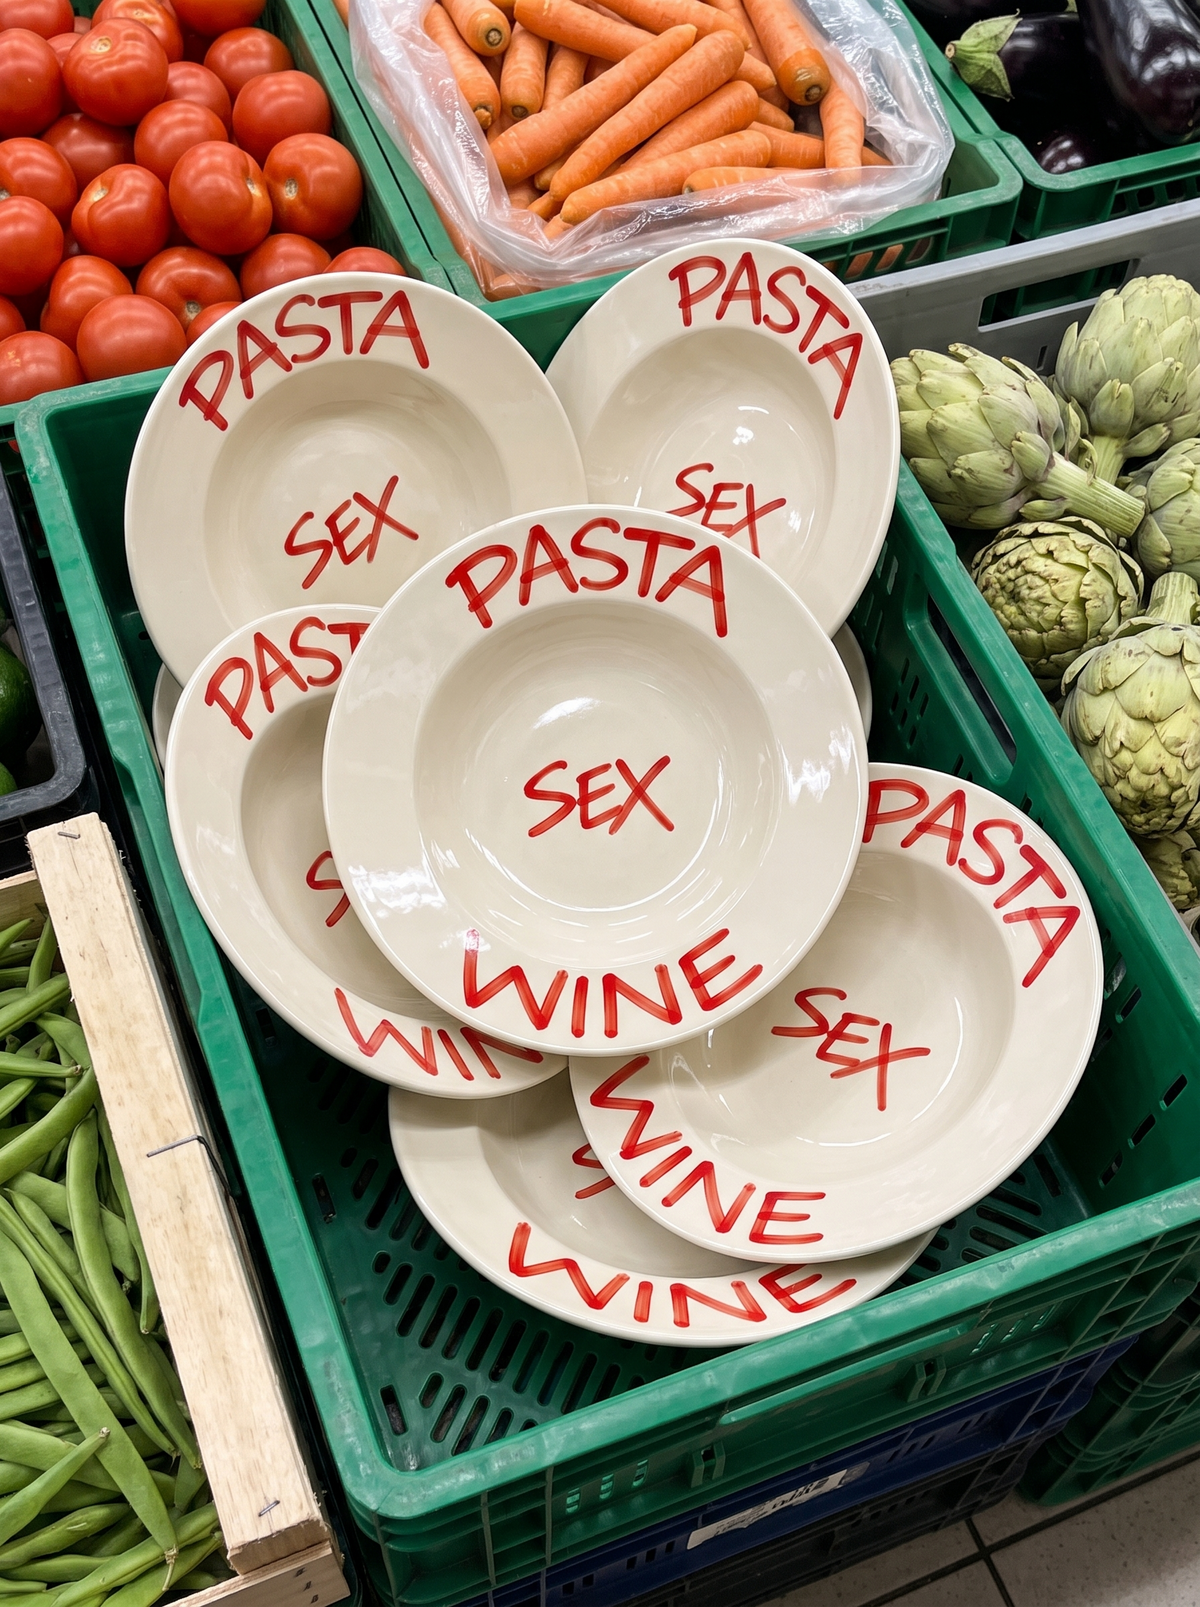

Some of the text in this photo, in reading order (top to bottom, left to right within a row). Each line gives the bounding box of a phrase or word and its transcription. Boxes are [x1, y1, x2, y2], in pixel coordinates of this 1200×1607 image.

[178, 290, 430, 432] PASTA
[668, 252, 863, 420] PASTA
[284, 475, 419, 589] SEX
[666, 462, 787, 559] SEX
[445, 517, 728, 638] PASTA
[524, 756, 675, 837] SEX
[862, 779, 1080, 988] PASTA
[463, 928, 763, 1038] WINE
[771, 987, 931, 1111] SEX
[590, 1055, 826, 1245] WINE
[509, 1222, 857, 1328] WINE
